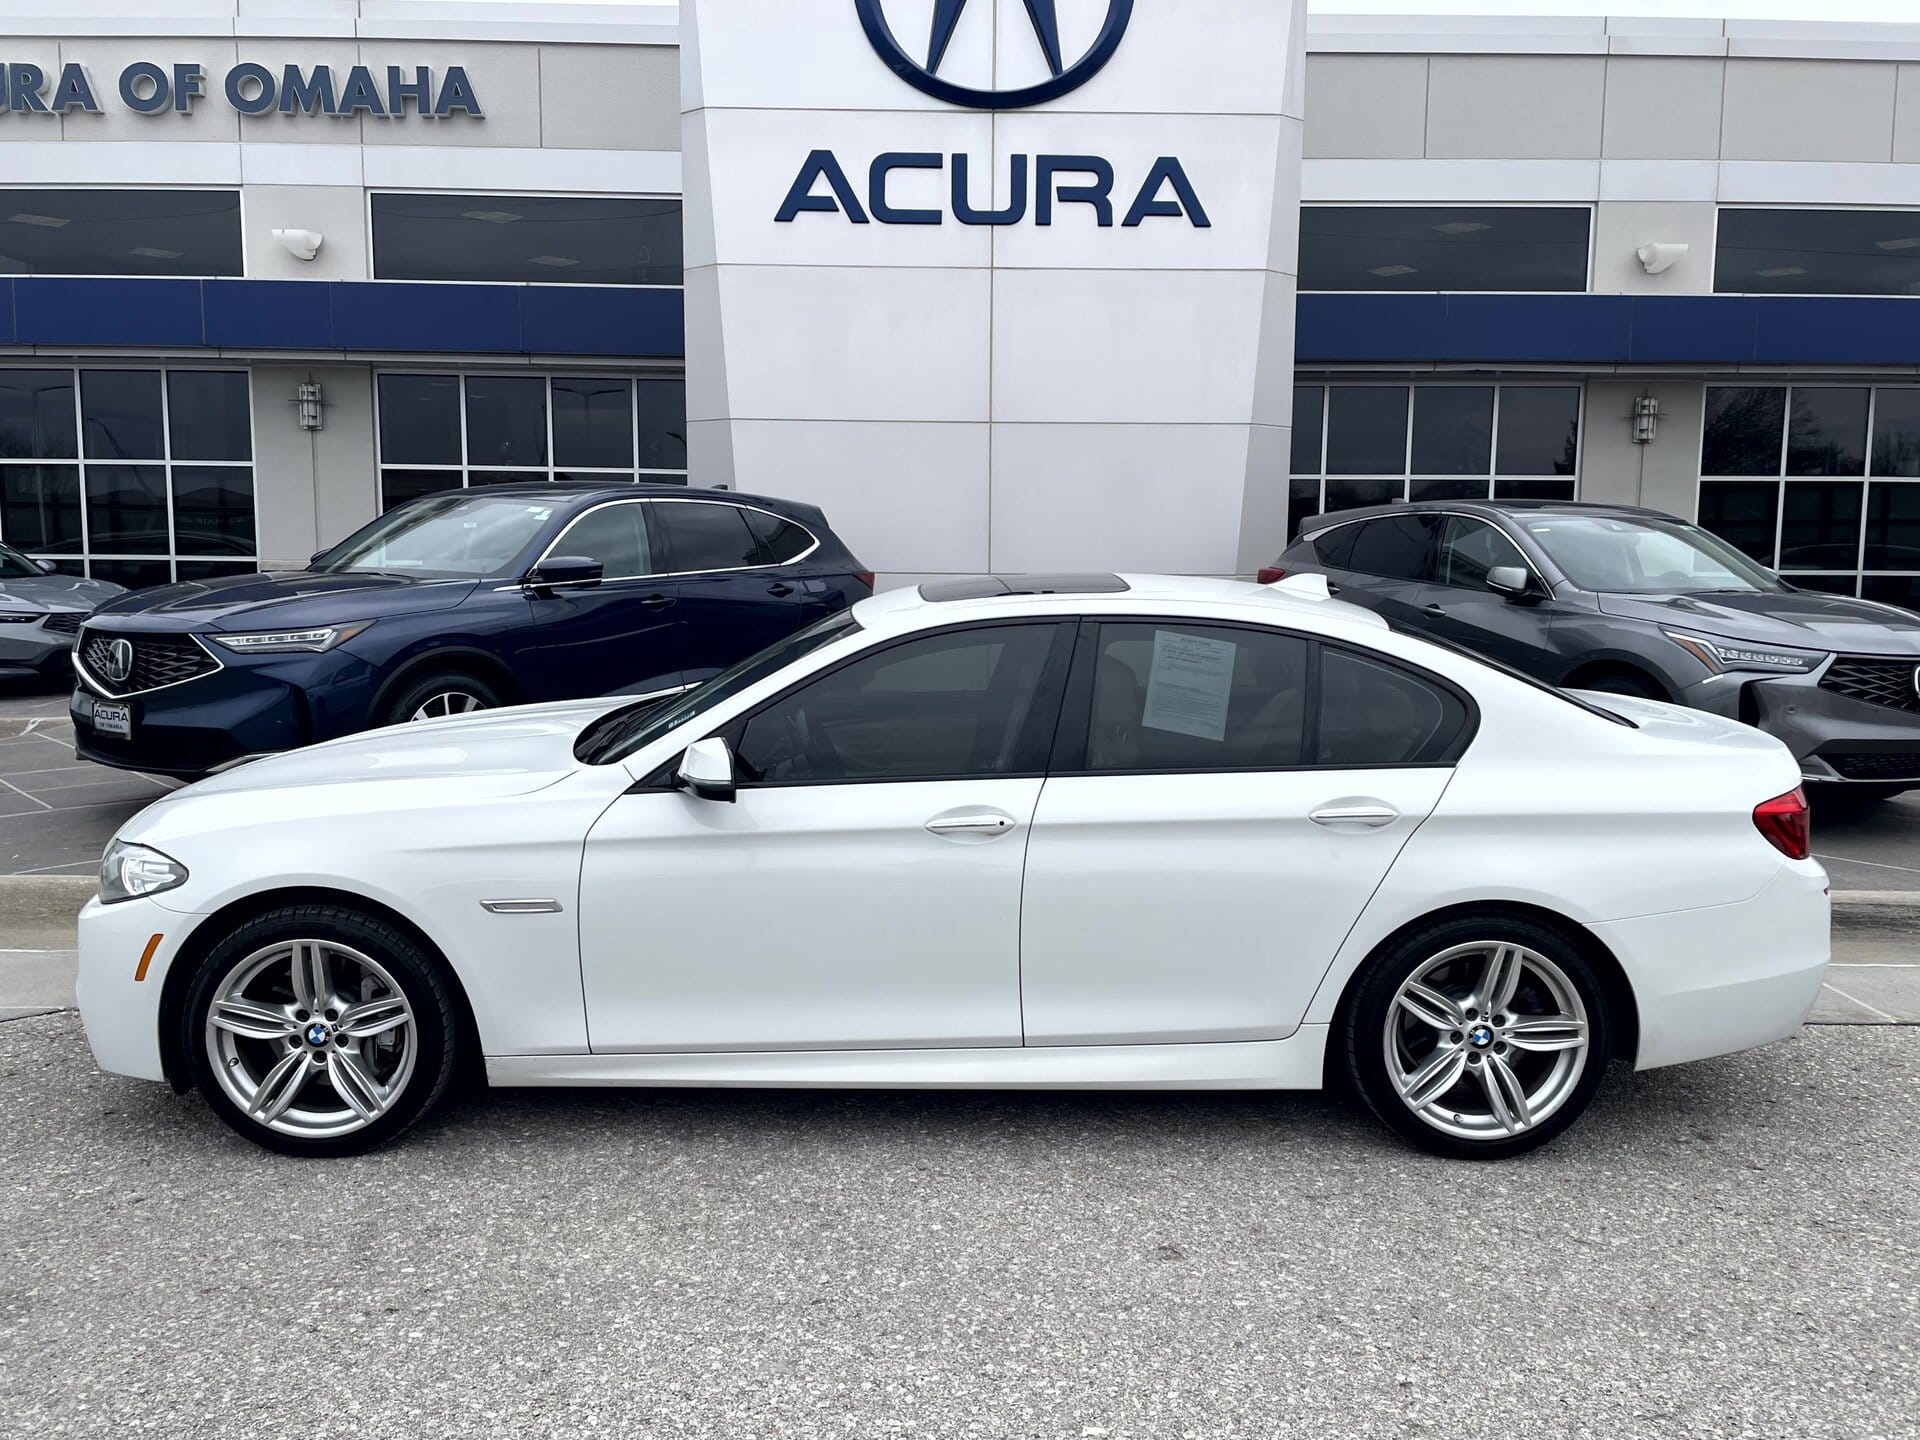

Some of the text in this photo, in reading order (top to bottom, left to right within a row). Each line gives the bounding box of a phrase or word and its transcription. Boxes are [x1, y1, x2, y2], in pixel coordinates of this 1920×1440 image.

[0, 61, 484, 118] RA OF OMAHA
[774, 149, 1212, 228] ACURA
[94, 709, 129, 722] ACURA
